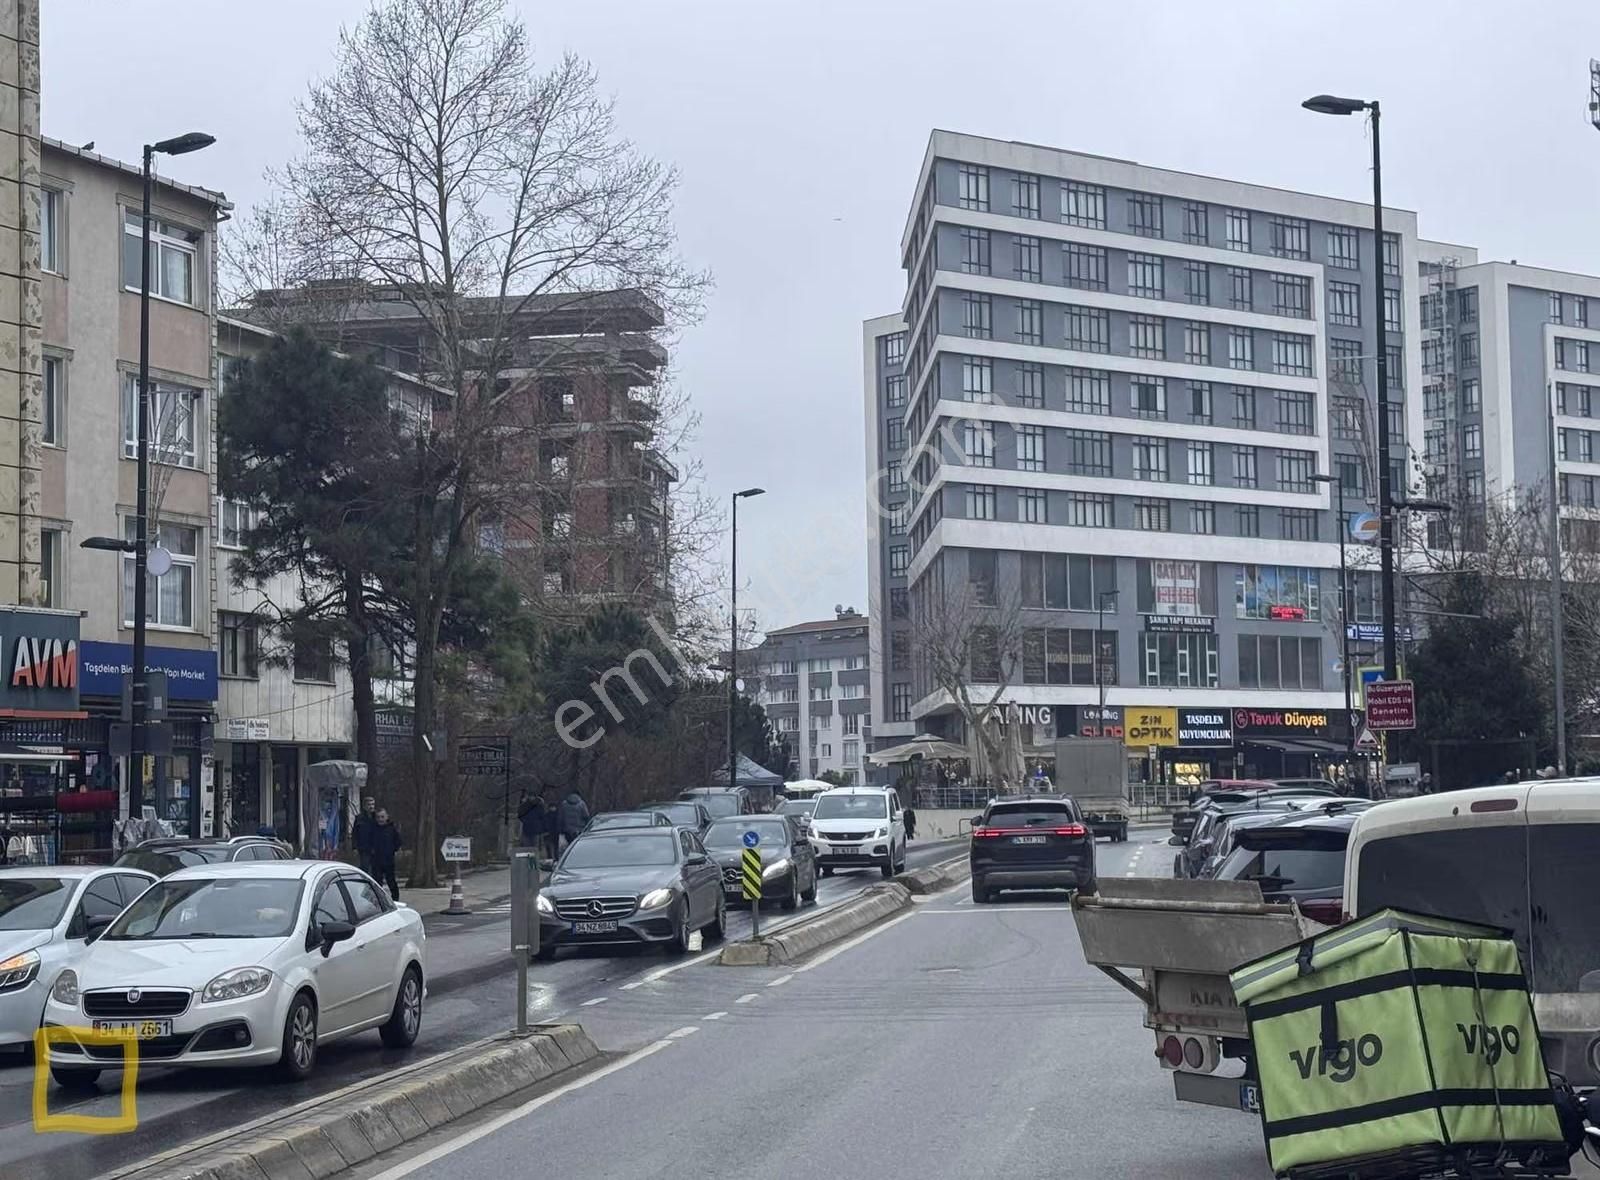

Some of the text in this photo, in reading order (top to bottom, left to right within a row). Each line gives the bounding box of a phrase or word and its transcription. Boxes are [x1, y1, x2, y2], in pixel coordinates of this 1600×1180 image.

[13, 636, 76, 688] AVM
[84, 662, 120, 676] Taşdelen
[121, 664, 134, 674] Bin
[163, 667, 180, 679] Yapı
[180, 669, 206, 681] Market
[1185, 714, 1224, 726] TAŞDELEN
[1250, 711, 1328, 729] Tavuk Dünyası
[1372, 707, 1409, 715] Denetim
[1179, 729, 1231, 740] KUYUMCULUK
[1456, 1021, 1521, 1066] vigo
[1289, 1032, 1383, 1083] vigo
